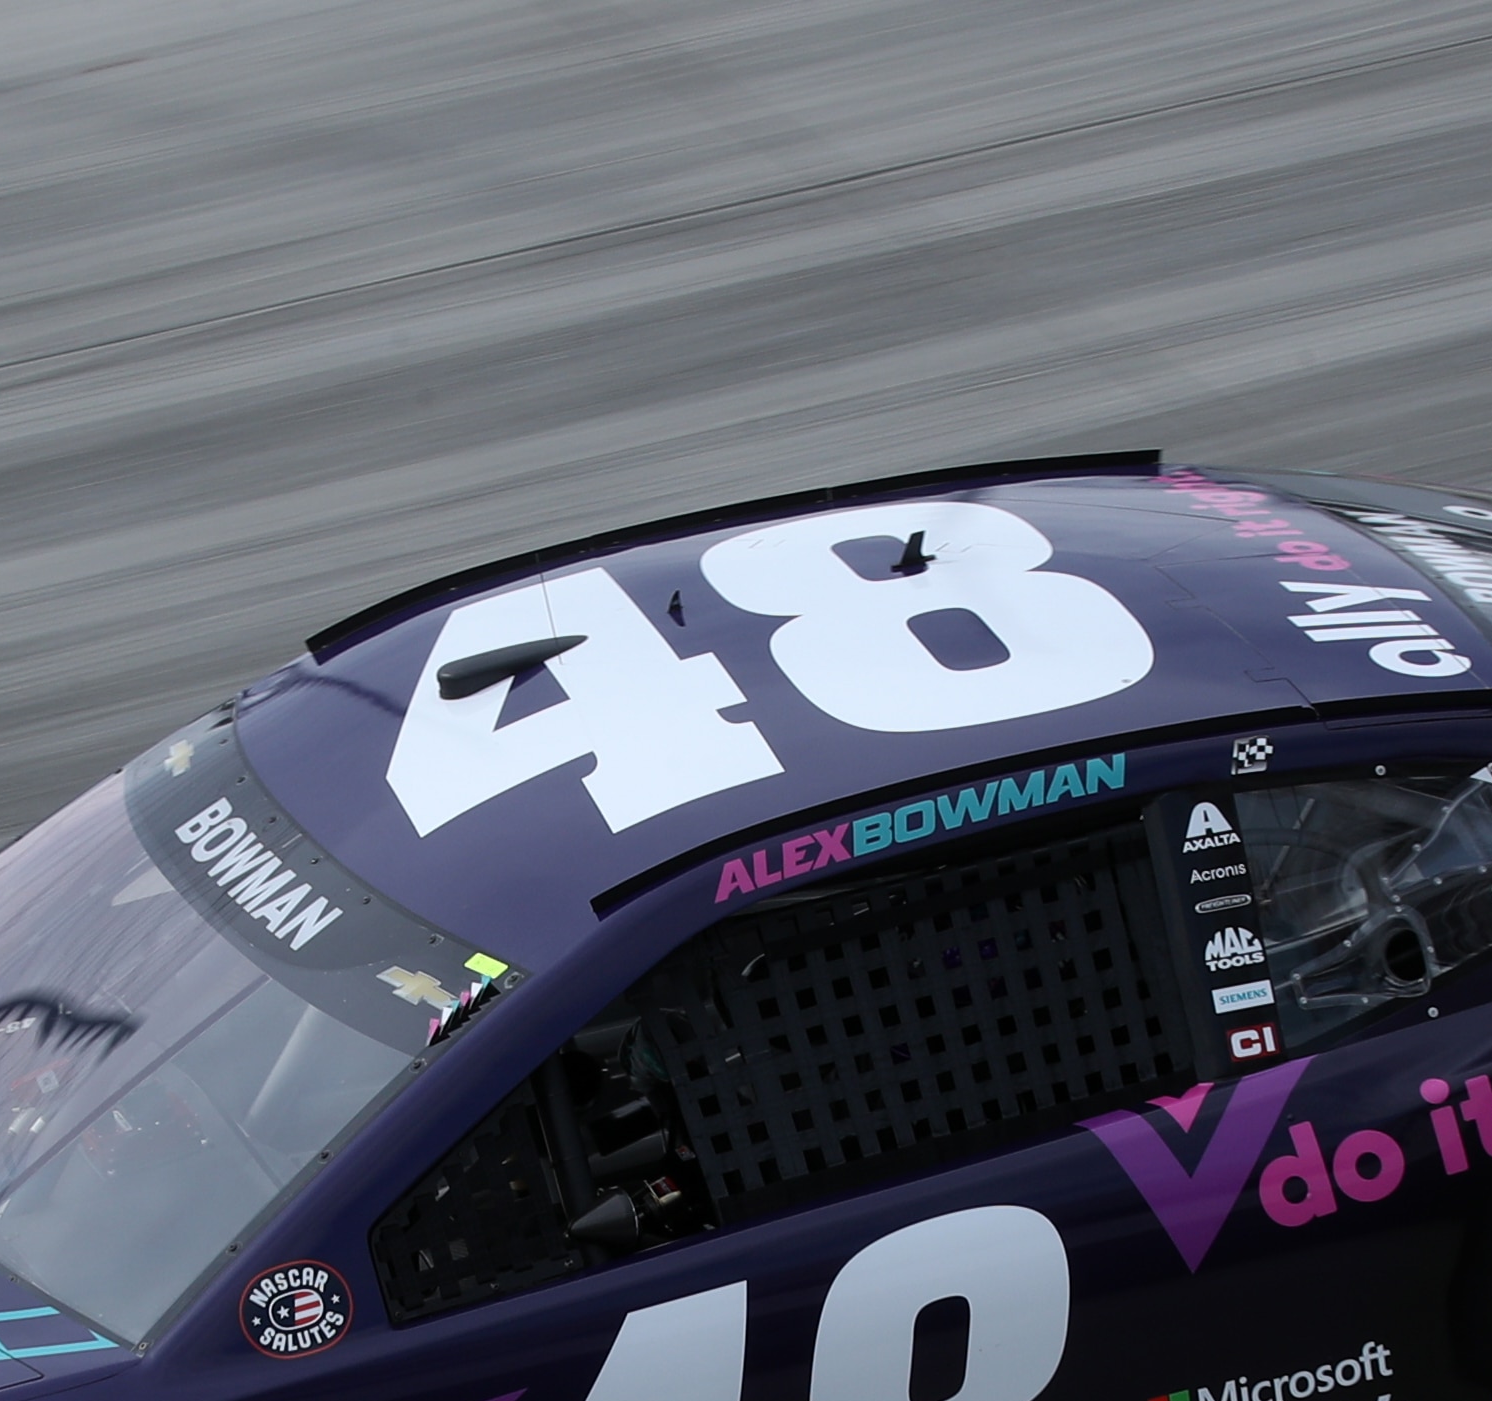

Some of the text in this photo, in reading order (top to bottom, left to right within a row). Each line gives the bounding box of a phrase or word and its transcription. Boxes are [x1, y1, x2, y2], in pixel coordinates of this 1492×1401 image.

[1279, 580, 1472, 677] ally
[385, 501, 1155, 838] 48
[1182, 832, 1242, 854] AXALTA
[174, 796, 344, 951] BOWMAN
[1189, 863, 1247, 884] Acronis
[1205, 926, 1264, 961] MAC
[1205, 951, 1265, 972] TOOLS
[1218, 987, 1268, 1005] SIEMENS
[1230, 1026, 1276, 1058] CI
[1259, 1121, 1405, 1227] do
[249, 1267, 329, 1308] NASCAR
[259, 1311, 345, 1352] SALUTES
